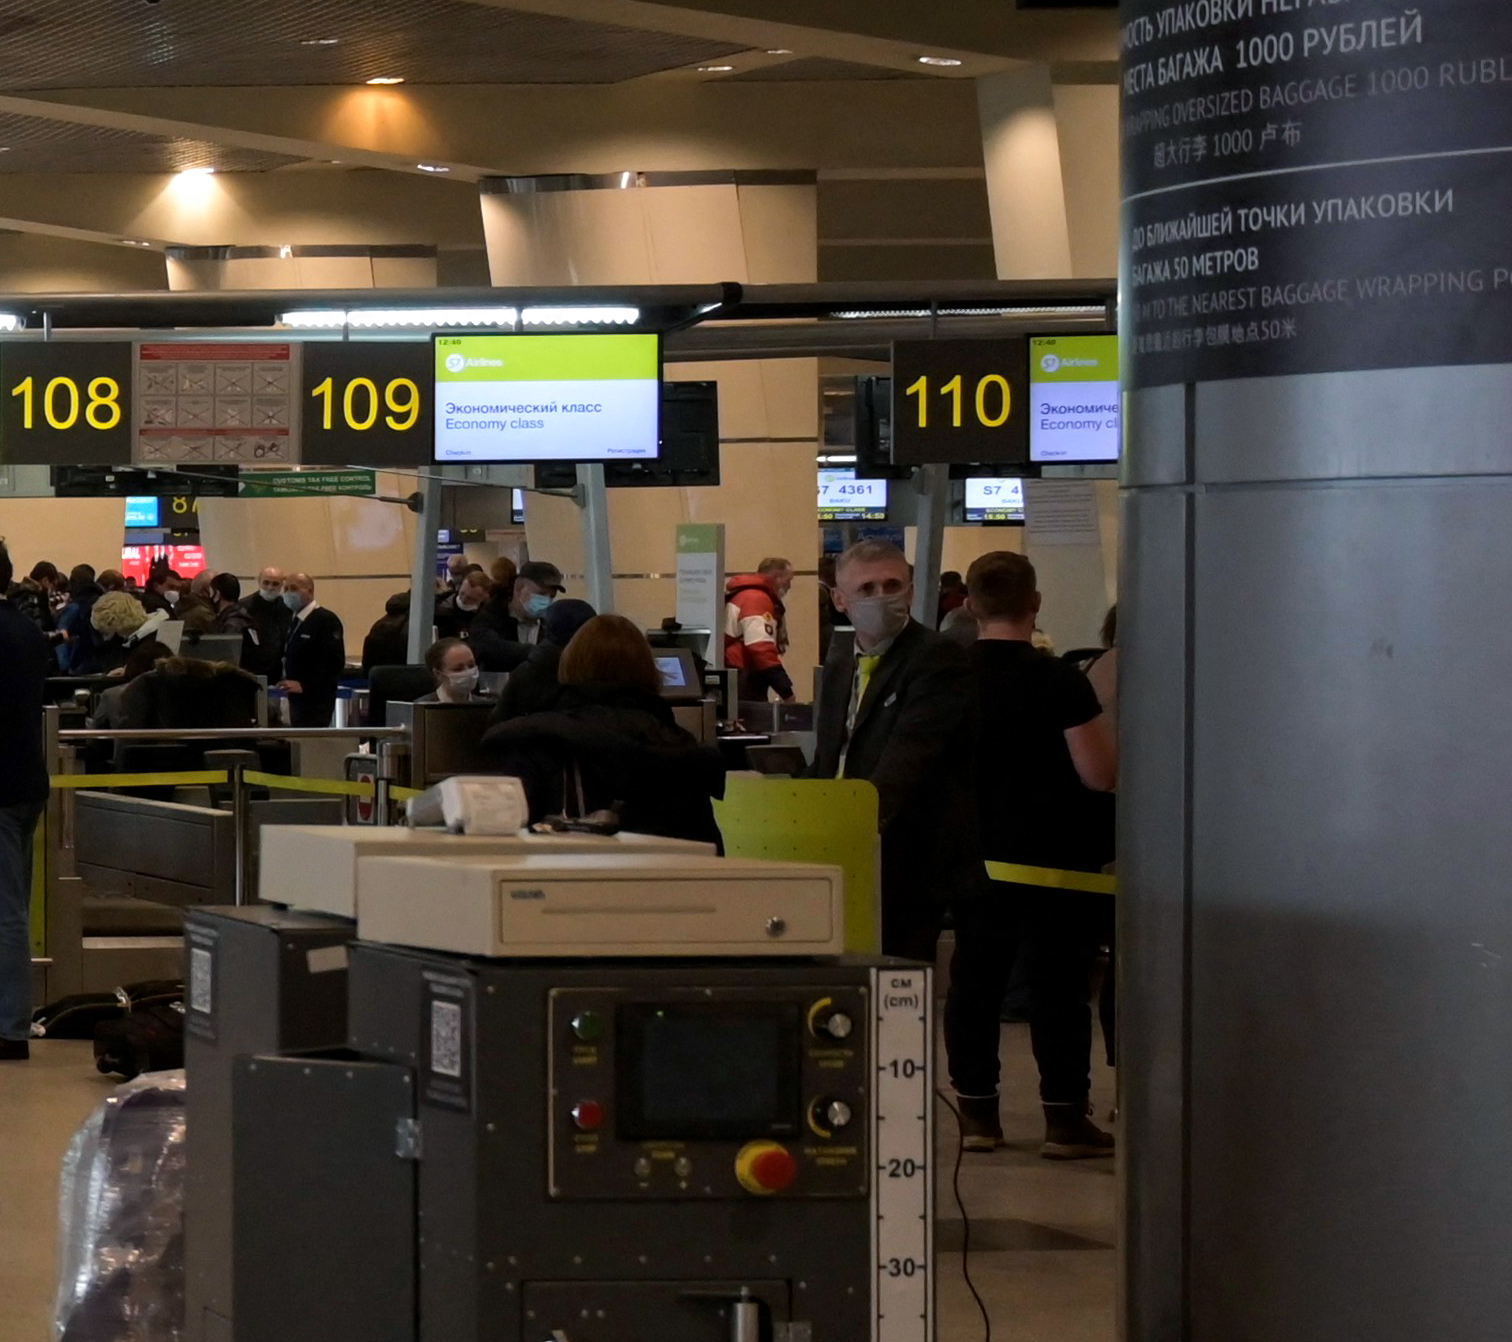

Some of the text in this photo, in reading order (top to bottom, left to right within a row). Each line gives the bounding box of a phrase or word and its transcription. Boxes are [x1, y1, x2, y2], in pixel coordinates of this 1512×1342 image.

[1157, 9, 1422, 86] БАГАЖА 1000 РУБЛЕЙ
[1173, 90, 1253, 126] OVERSIZED
[1260, 76, 1356, 109] BAGGAGE
[1368, 67, 1428, 96] 1000
[1213, 128, 1253, 157] 1000
[1147, 189, 1453, 247] БЛИЖАЙШЕЙ ТОЧКИ УПАКОВКИ
[1174, 256, 1188, 279] 50
[1192, 248, 1259, 277] МЕТРОВ
[1192, 269, 1484, 312] NEAREST BAGGAGE WRAPPING
[11, 376, 121, 430] 108
[310, 376, 420, 431] 109
[446, 402, 601, 414] Экономический класс
[905, 374, 1011, 428] 110
[446, 418, 544, 431] Economy class
[1040, 419, 1102, 431] Economy
[839, 485, 872, 495] 4361
[883, 993, 919, 1009] (cm)
[889, 1057, 914, 1078] 10
[889, 1158, 914, 1177] 20
[889, 1257, 914, 1277] 30
